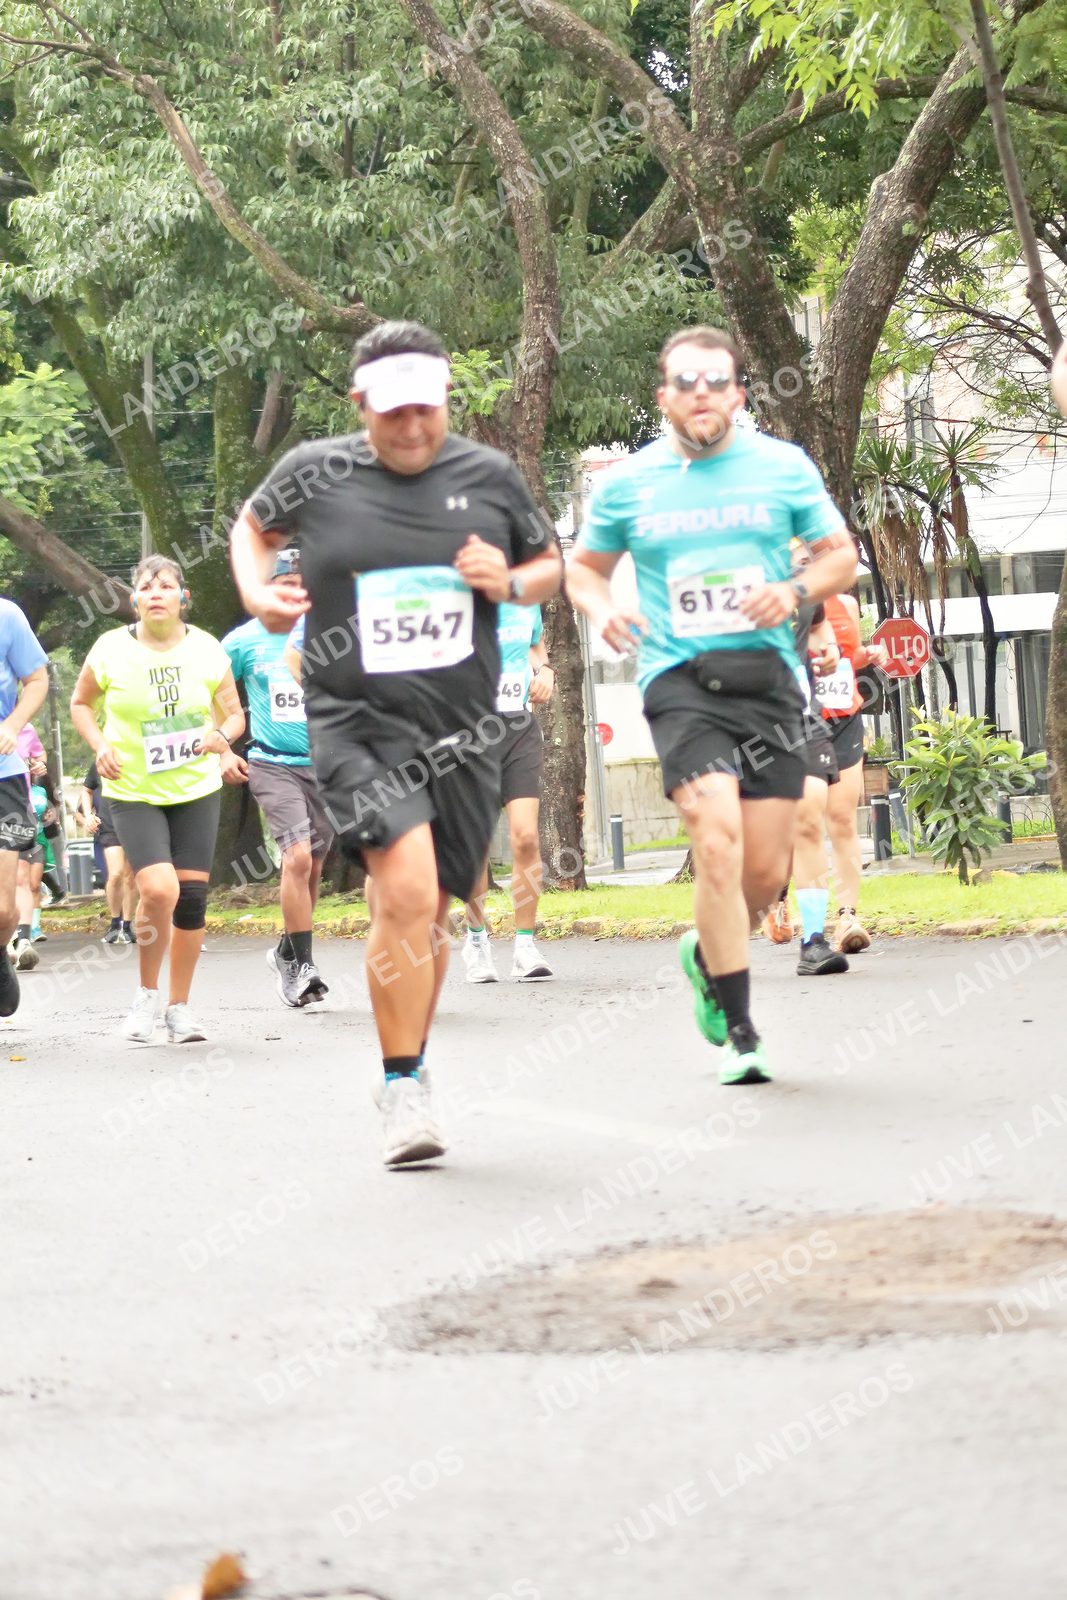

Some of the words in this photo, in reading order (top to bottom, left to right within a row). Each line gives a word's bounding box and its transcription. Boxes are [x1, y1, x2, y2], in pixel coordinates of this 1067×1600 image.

[636, 504, 772, 538] PERDURA
[679, 584, 751, 613] 612
[373, 611, 464, 645] 5547
[878, 635, 926, 660] ALTO
[149, 666, 182, 685] JUST
[157, 684, 180, 702] DO
[275, 692, 305, 708] 65
[497, 683, 522, 698] 49
[164, 702, 177, 718] IT
[149, 738, 202, 765] 2146
[1, 822, 35, 838] NIKE
